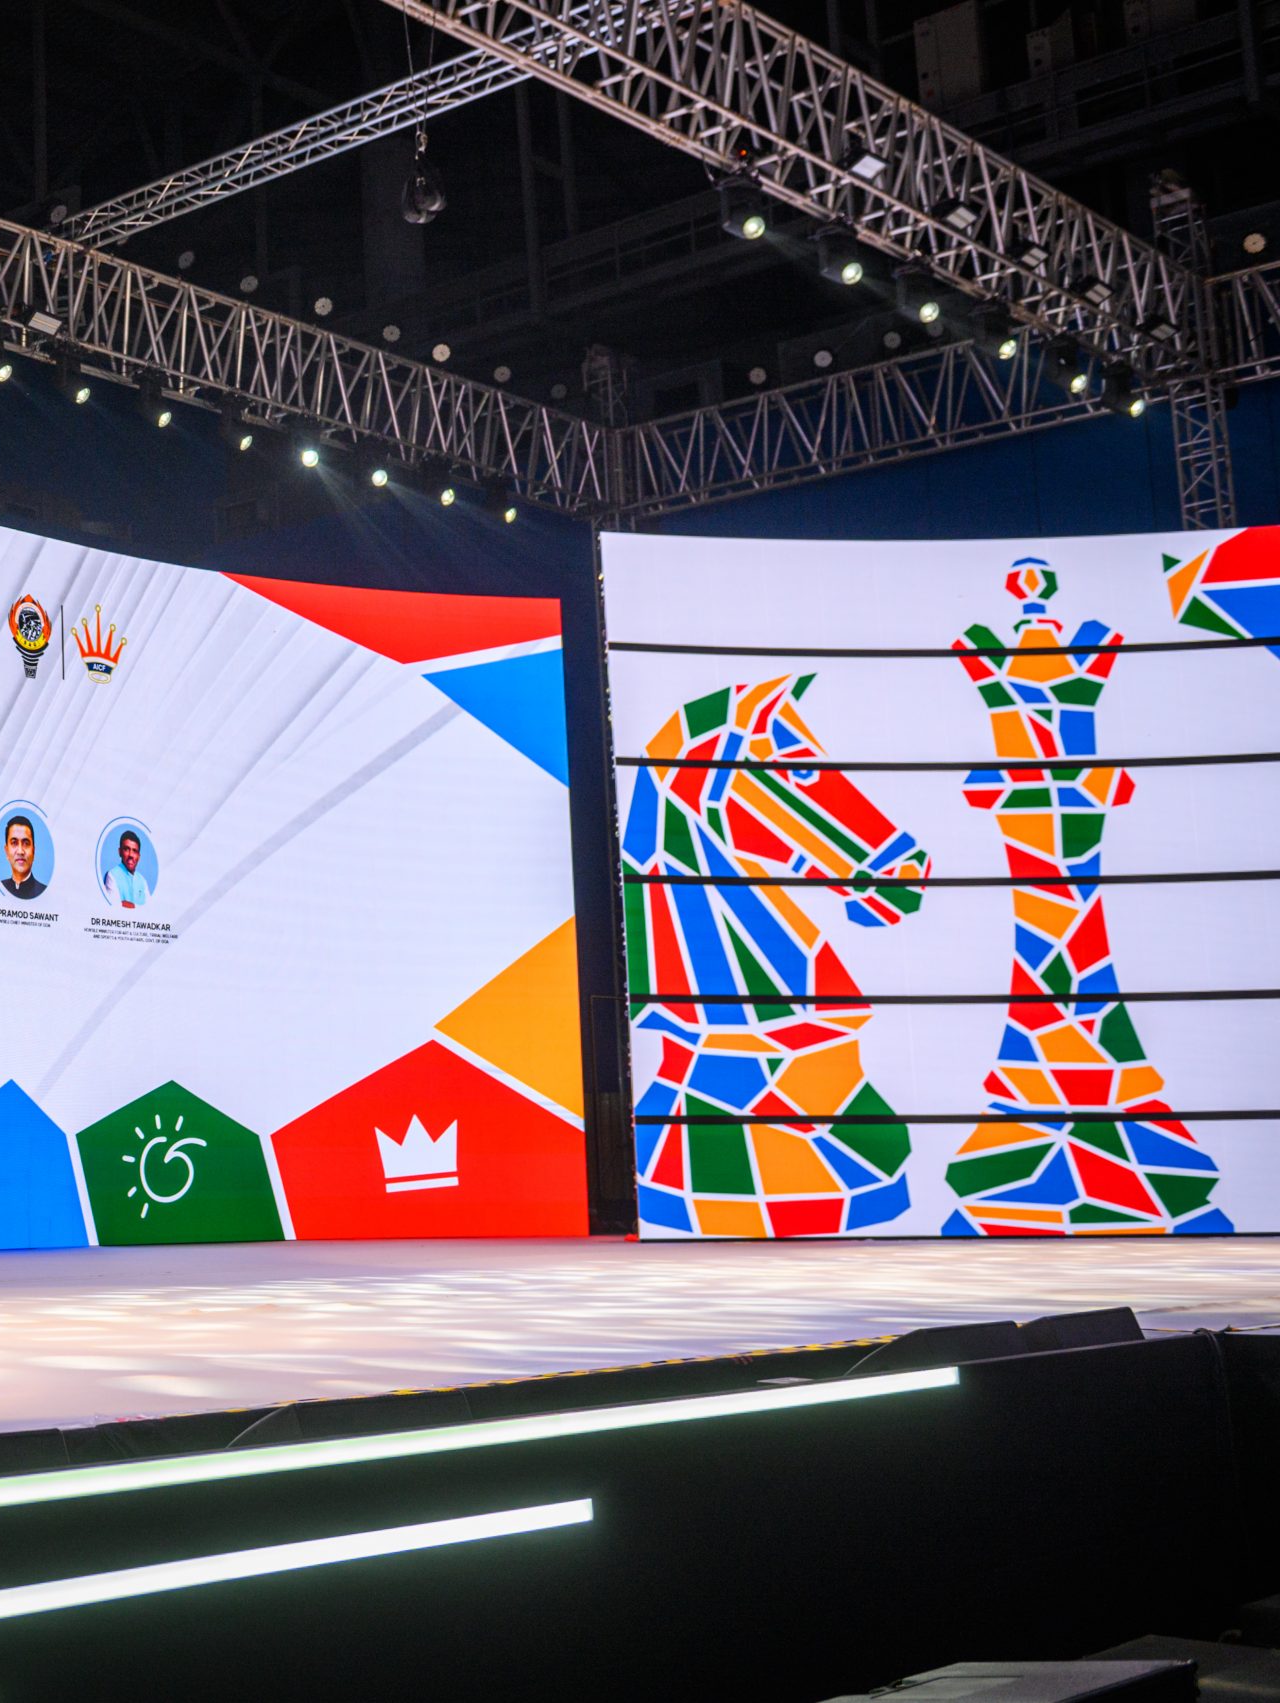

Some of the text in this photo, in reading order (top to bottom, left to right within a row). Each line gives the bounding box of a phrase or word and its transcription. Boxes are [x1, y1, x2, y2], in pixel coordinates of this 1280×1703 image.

[30, 912, 58, 921] SAWANT
[91, 918, 100, 926] DR
[102, 919, 130, 928] RAMESH
